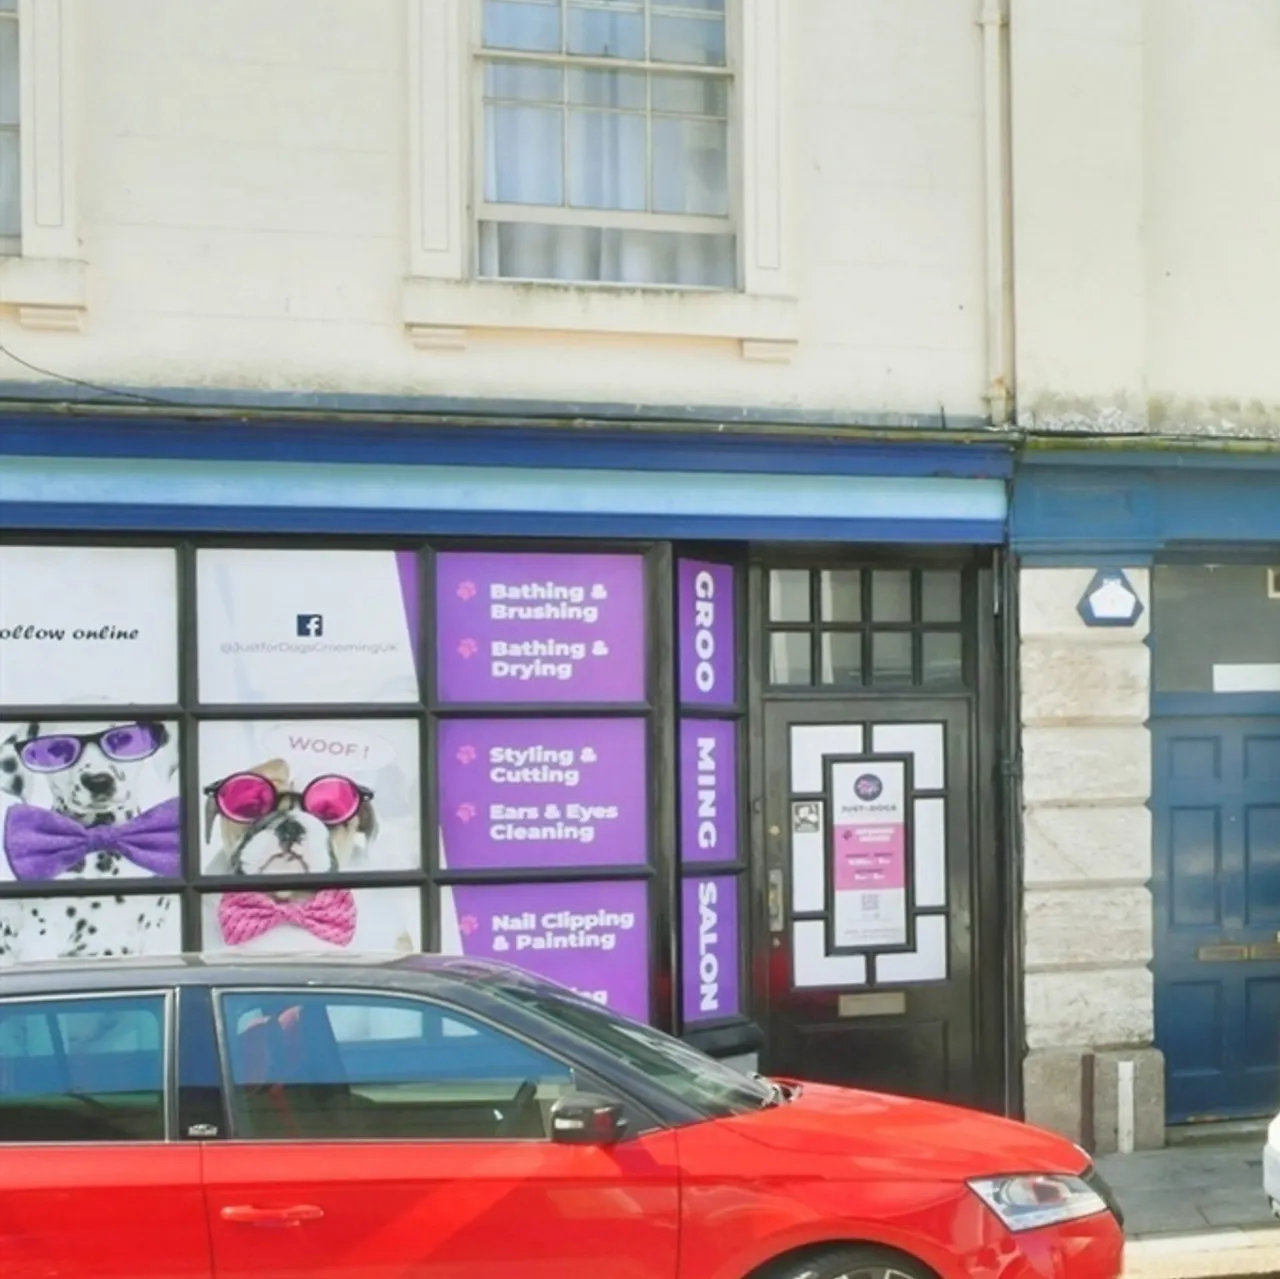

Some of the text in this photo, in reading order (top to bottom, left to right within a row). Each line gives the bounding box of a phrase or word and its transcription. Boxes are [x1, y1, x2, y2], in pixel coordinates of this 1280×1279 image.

[490, 582, 608, 603] Bathing &
[490, 602, 599, 623] Brushing
[0, 623, 140, 641] ollow online
[491, 639, 609, 660] Bathing &
[491, 658, 574, 680] Drying
[288, 734, 359, 756] WOOF
[489, 745, 597, 767] Styling &
[489, 765, 580, 787] Cutting
[695, 570, 720, 1012] GROO MING SALON
[489, 802, 619, 823] Ears & Eyes
[489, 821, 596, 843] Cleaning
[492, 908, 636, 932] Nail Clipping
[492, 931, 617, 952] & Painting
